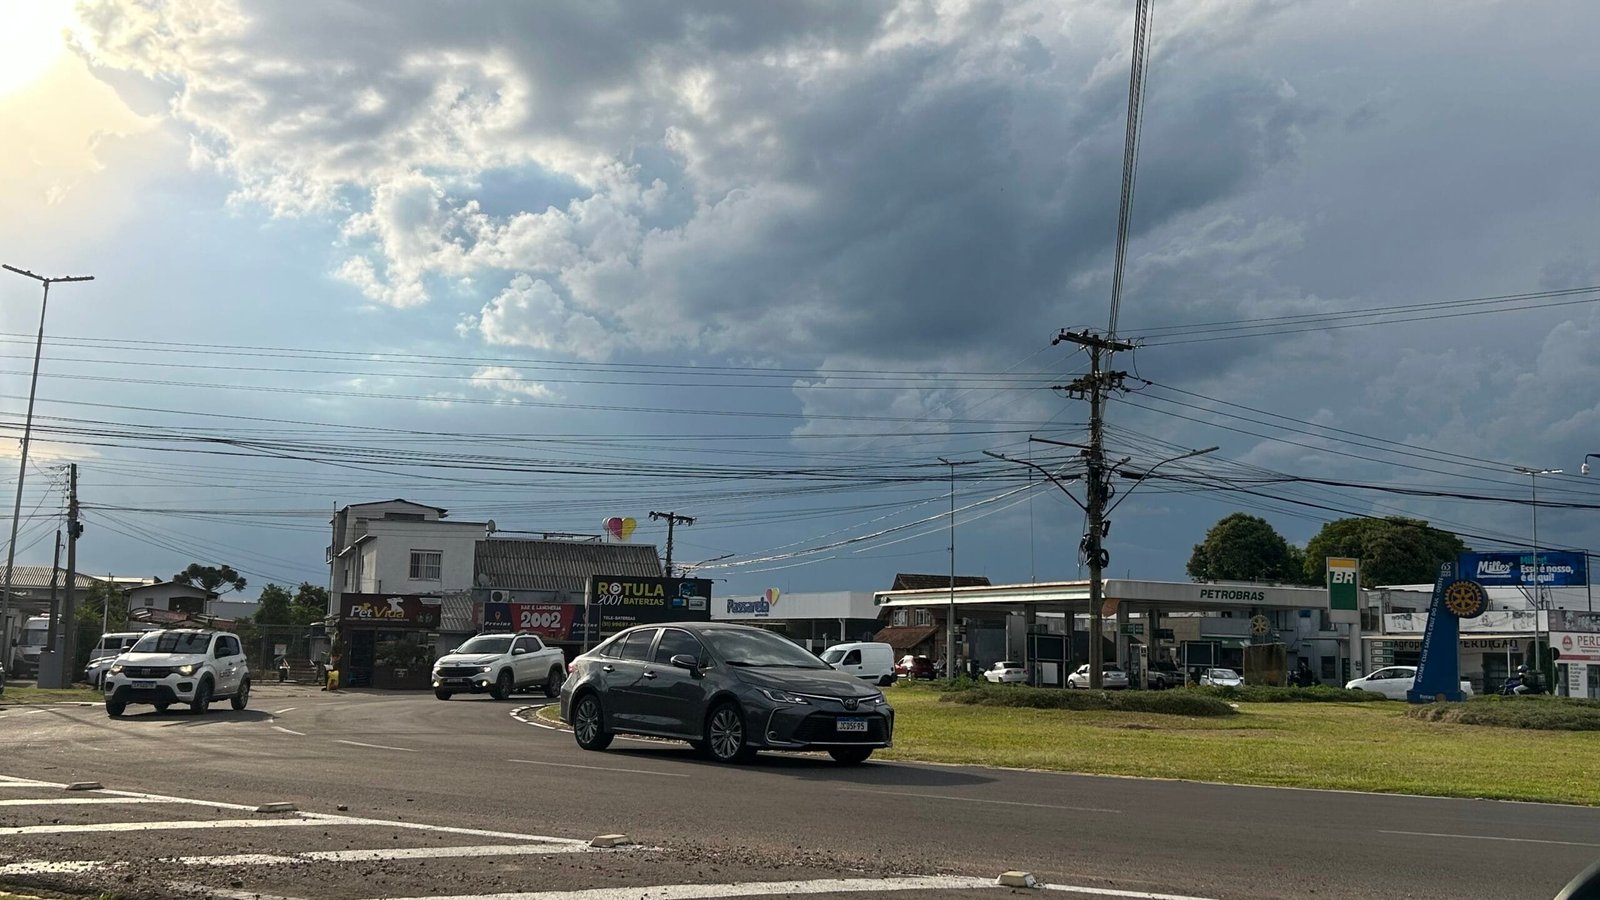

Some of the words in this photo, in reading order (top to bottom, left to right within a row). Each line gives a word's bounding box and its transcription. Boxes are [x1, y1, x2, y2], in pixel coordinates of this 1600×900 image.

[1441, 562, 1451, 571] 65
[1477, 561, 1510, 574] Miller
[1546, 565, 1574, 575] nosso,
[1332, 571, 1354, 584] BR
[598, 594, 623, 605] 2001
[623, 597, 665, 606] BATERIAS
[1200, 589, 1265, 601] PETROBRAS
[520, 611, 561, 628] 2002
[1393, 640, 1422, 650] Agrop
[1417, 663, 1425, 682] ROTARY
[1424, 632, 1432, 648] SANTA
[1431, 607, 1437, 617] DO
